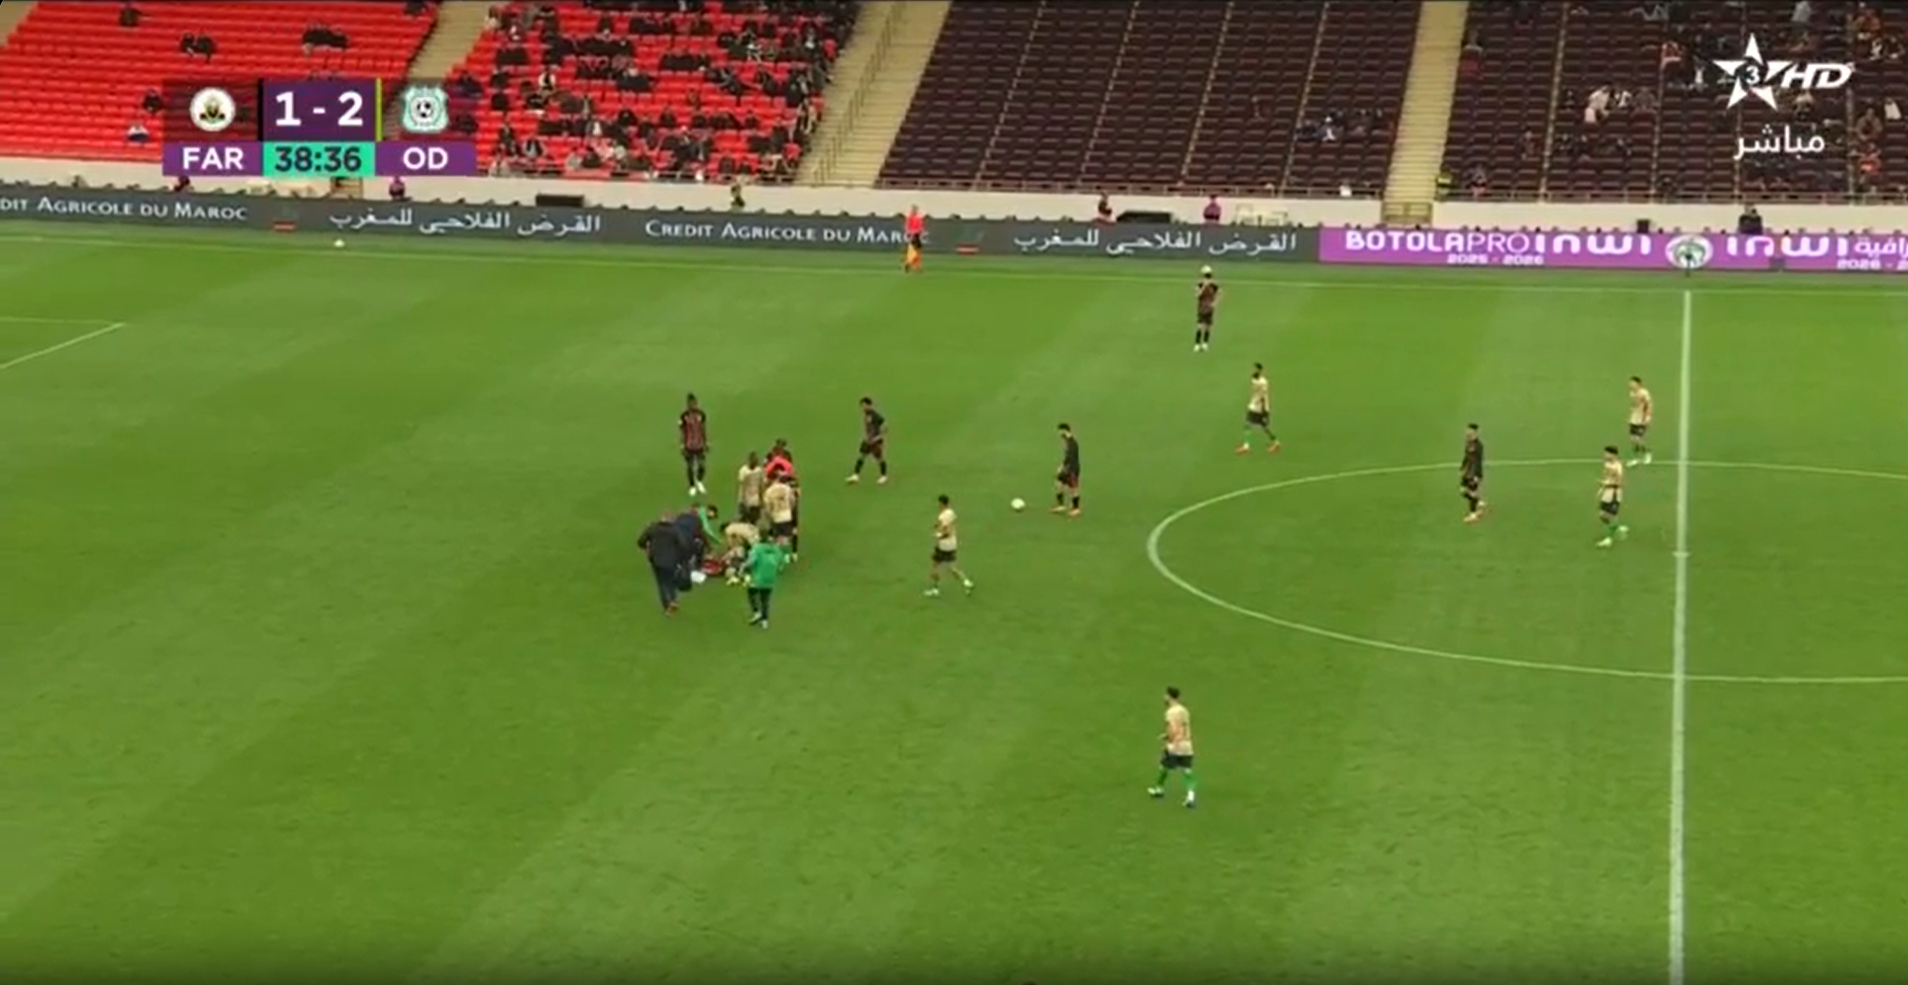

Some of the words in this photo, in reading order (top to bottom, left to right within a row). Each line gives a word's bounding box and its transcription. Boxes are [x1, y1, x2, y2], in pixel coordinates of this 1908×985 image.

[37, 196, 134, 216] AGRICOLE
[140, 203, 169, 217] DU
[174, 201, 248, 220] MAROC
[329, 206, 414, 230] للمغرب
[517, 213, 601, 236] القرض
[645, 219, 713, 238] CREDIT
[721, 222, 816, 241] AGRICOLE
[823, 225, 850, 241] DU
[1013, 228, 1100, 252] للمغرب
[1208, 232, 1297, 256] القرض
